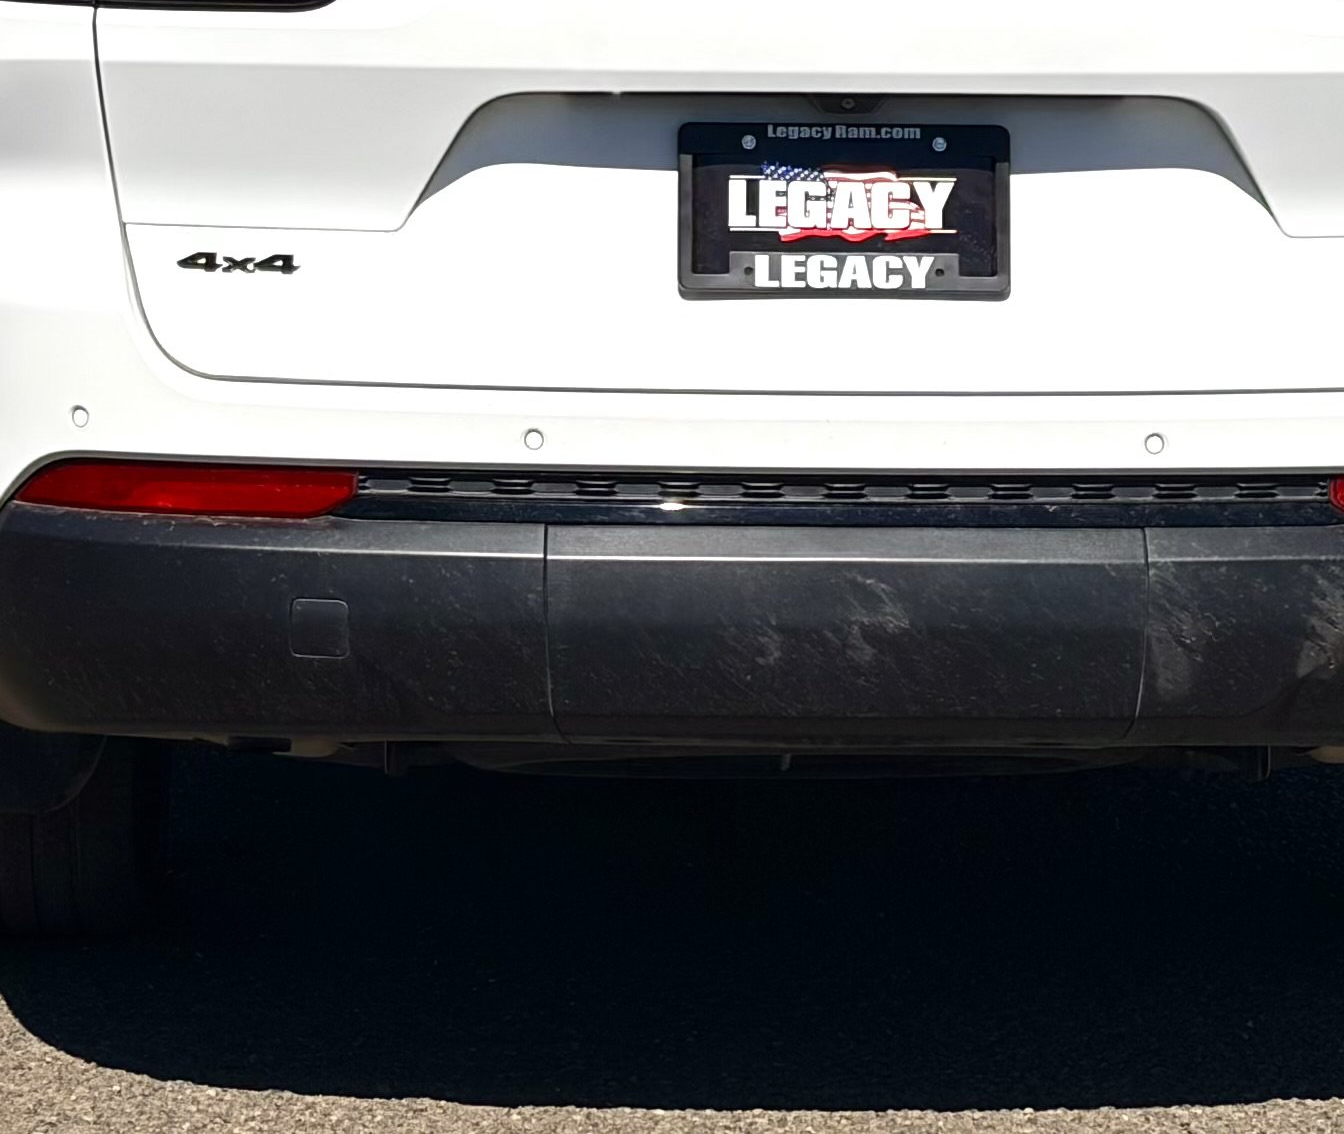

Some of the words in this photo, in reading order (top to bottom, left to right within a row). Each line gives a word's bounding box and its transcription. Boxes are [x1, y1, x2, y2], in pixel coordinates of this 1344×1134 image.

[727, 179, 957, 229] LEGACY
[176, 252, 302, 274] 4x4
[754, 254, 936, 289] LEGACY
